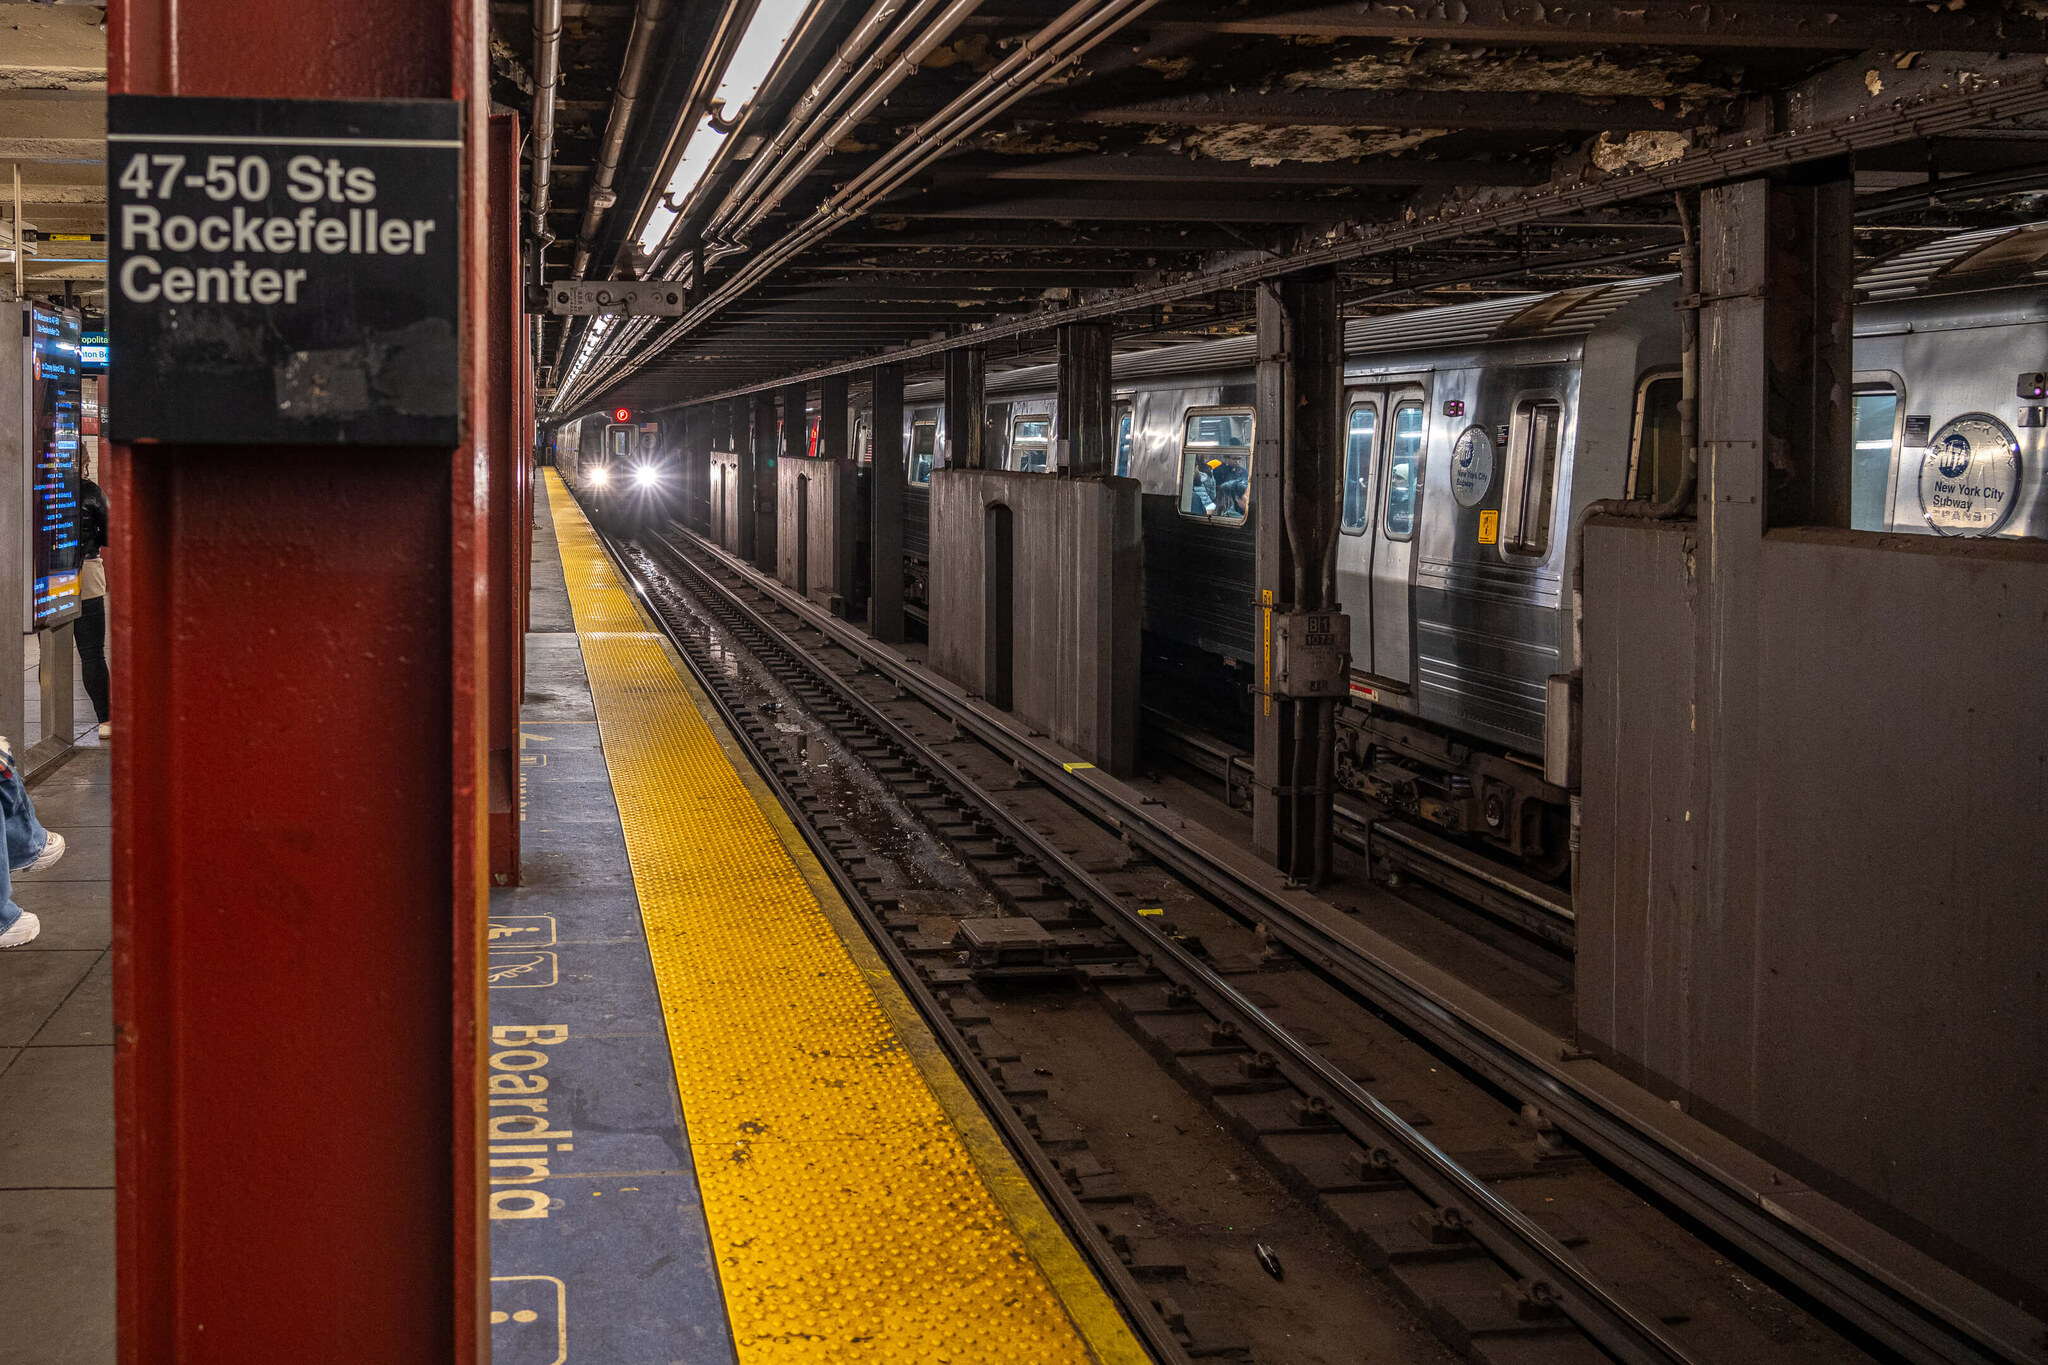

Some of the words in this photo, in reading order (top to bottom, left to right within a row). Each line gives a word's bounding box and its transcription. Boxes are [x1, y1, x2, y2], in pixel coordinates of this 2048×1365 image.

[119, 153, 271, 201] 47-50
[286, 155, 377, 202] Sts
[120, 204, 435, 255] Rockefeller
[119, 254, 307, 304] Center
[1933, 494, 1973, 512] Subway
[1934, 481, 1955, 493] New
[1959, 484, 1981, 497] York
[1983, 487, 2004, 502] City
